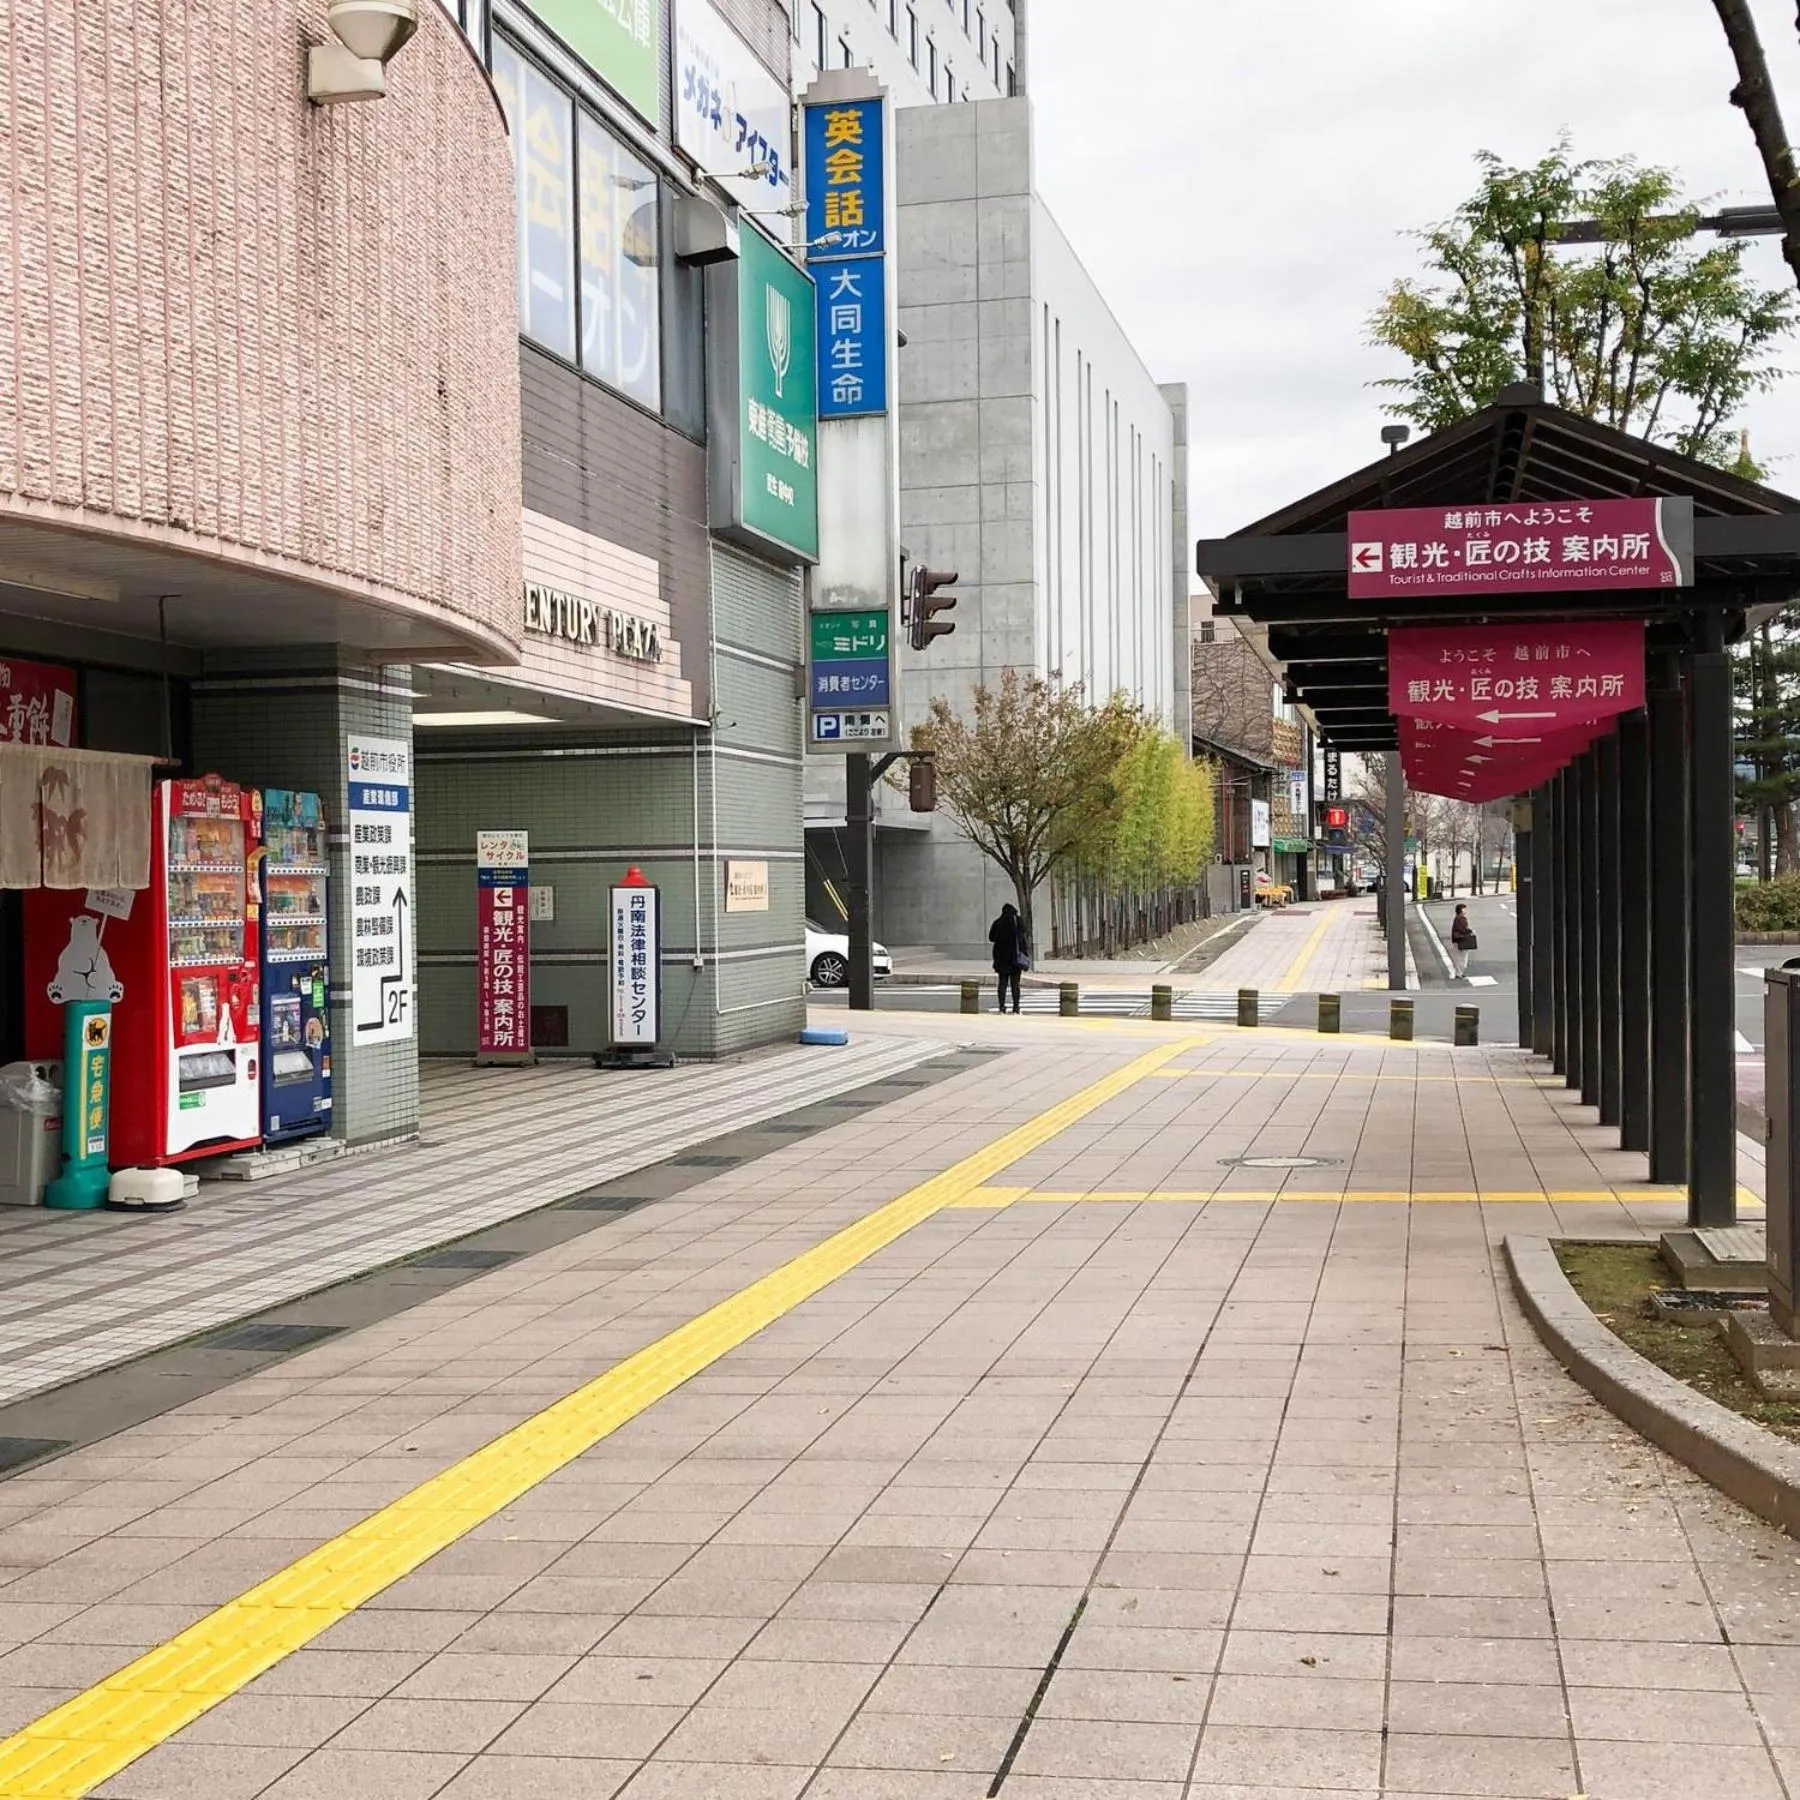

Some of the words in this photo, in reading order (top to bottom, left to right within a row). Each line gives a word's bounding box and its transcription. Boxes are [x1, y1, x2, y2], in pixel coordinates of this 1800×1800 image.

[684, 65, 722, 131] メガネ
[824, 108, 864, 228] 英会話
[828, 268, 864, 405] 大同生命
[1444, 506, 1593, 530] 越前市へようこそ
[1389, 536, 1552, 570] 観光・匠の技
[1561, 531, 1651, 563] 案内所
[1389, 572, 1425, 584] Tourist
[1426, 573, 1435, 583] &
[1437, 570, 1497, 583] Traditional
[1498, 568, 1536, 580] Crafts
[1538, 566, 1607, 579] Information
[1608, 565, 1651, 577] Center
[833, 634, 886, 652] ミドリ
[1440, 648, 1496, 664] ようこそ
[1514, 643, 1591, 662] 越前市へ
[818, 674, 885, 693] 消費者センター
[1408, 675, 1539, 703] 観光・匠の技
[1550, 673, 1625, 700] 案内所
[1327, 751, 1339, 801] まるたけ
[486, 851, 525, 861] サイクル
[493, 910, 514, 995] 観光・匠の技
[630, 895, 647, 1036] 丹南法律相談センター
[388, 989, 408, 1024] 2F
[493, 999, 514, 1047] 案内所
